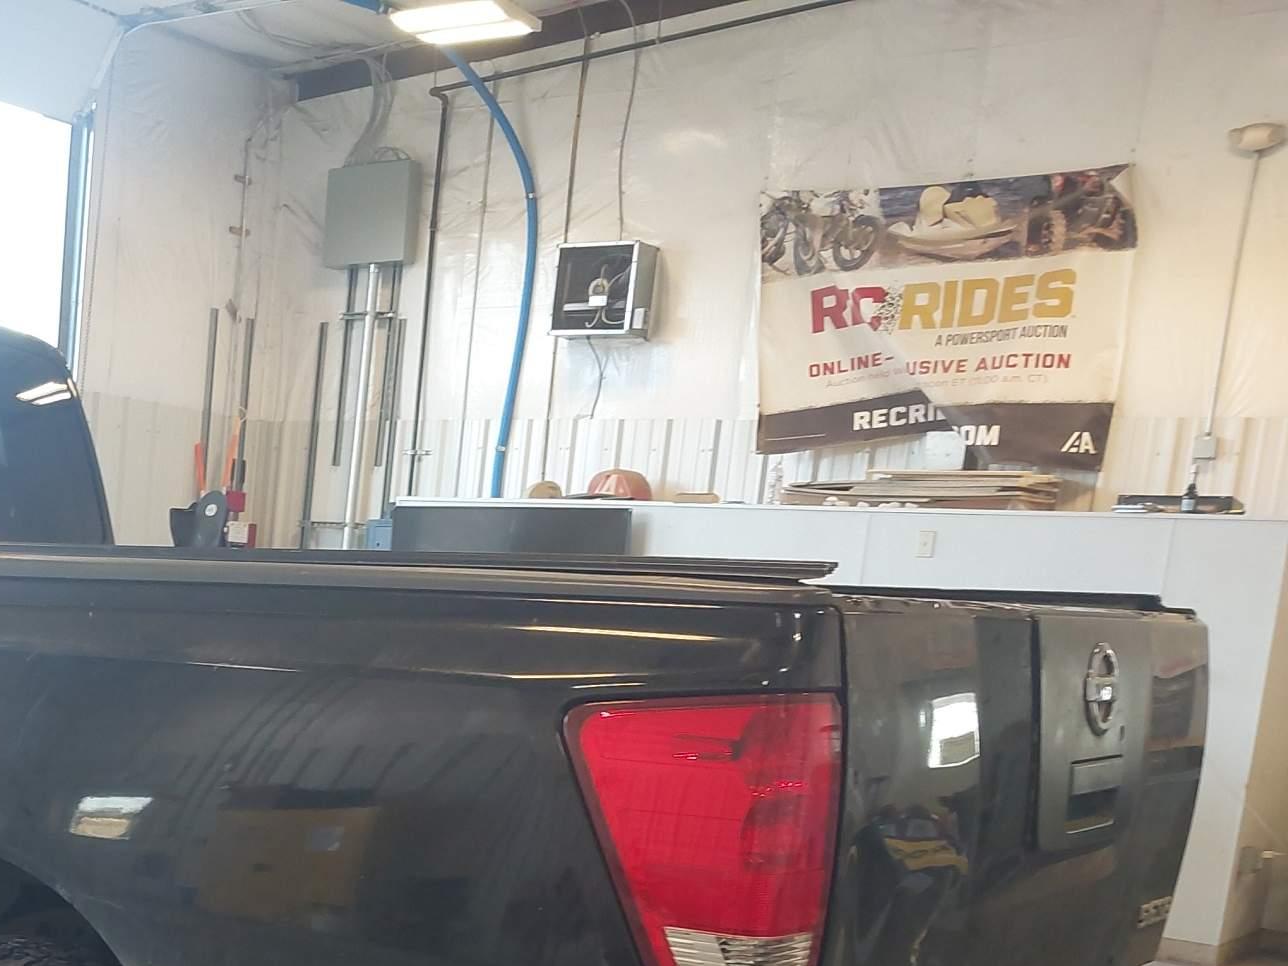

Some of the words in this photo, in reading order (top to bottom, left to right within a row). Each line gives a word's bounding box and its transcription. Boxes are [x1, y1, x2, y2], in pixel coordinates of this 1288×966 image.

[898, 268, 1077, 331] RIDES
[935, 335, 943, 347] A
[1019, 325, 1069, 339] AUCTION
[808, 352, 894, 377] ONLINE-
[975, 353, 1073, 371] AUCTION
